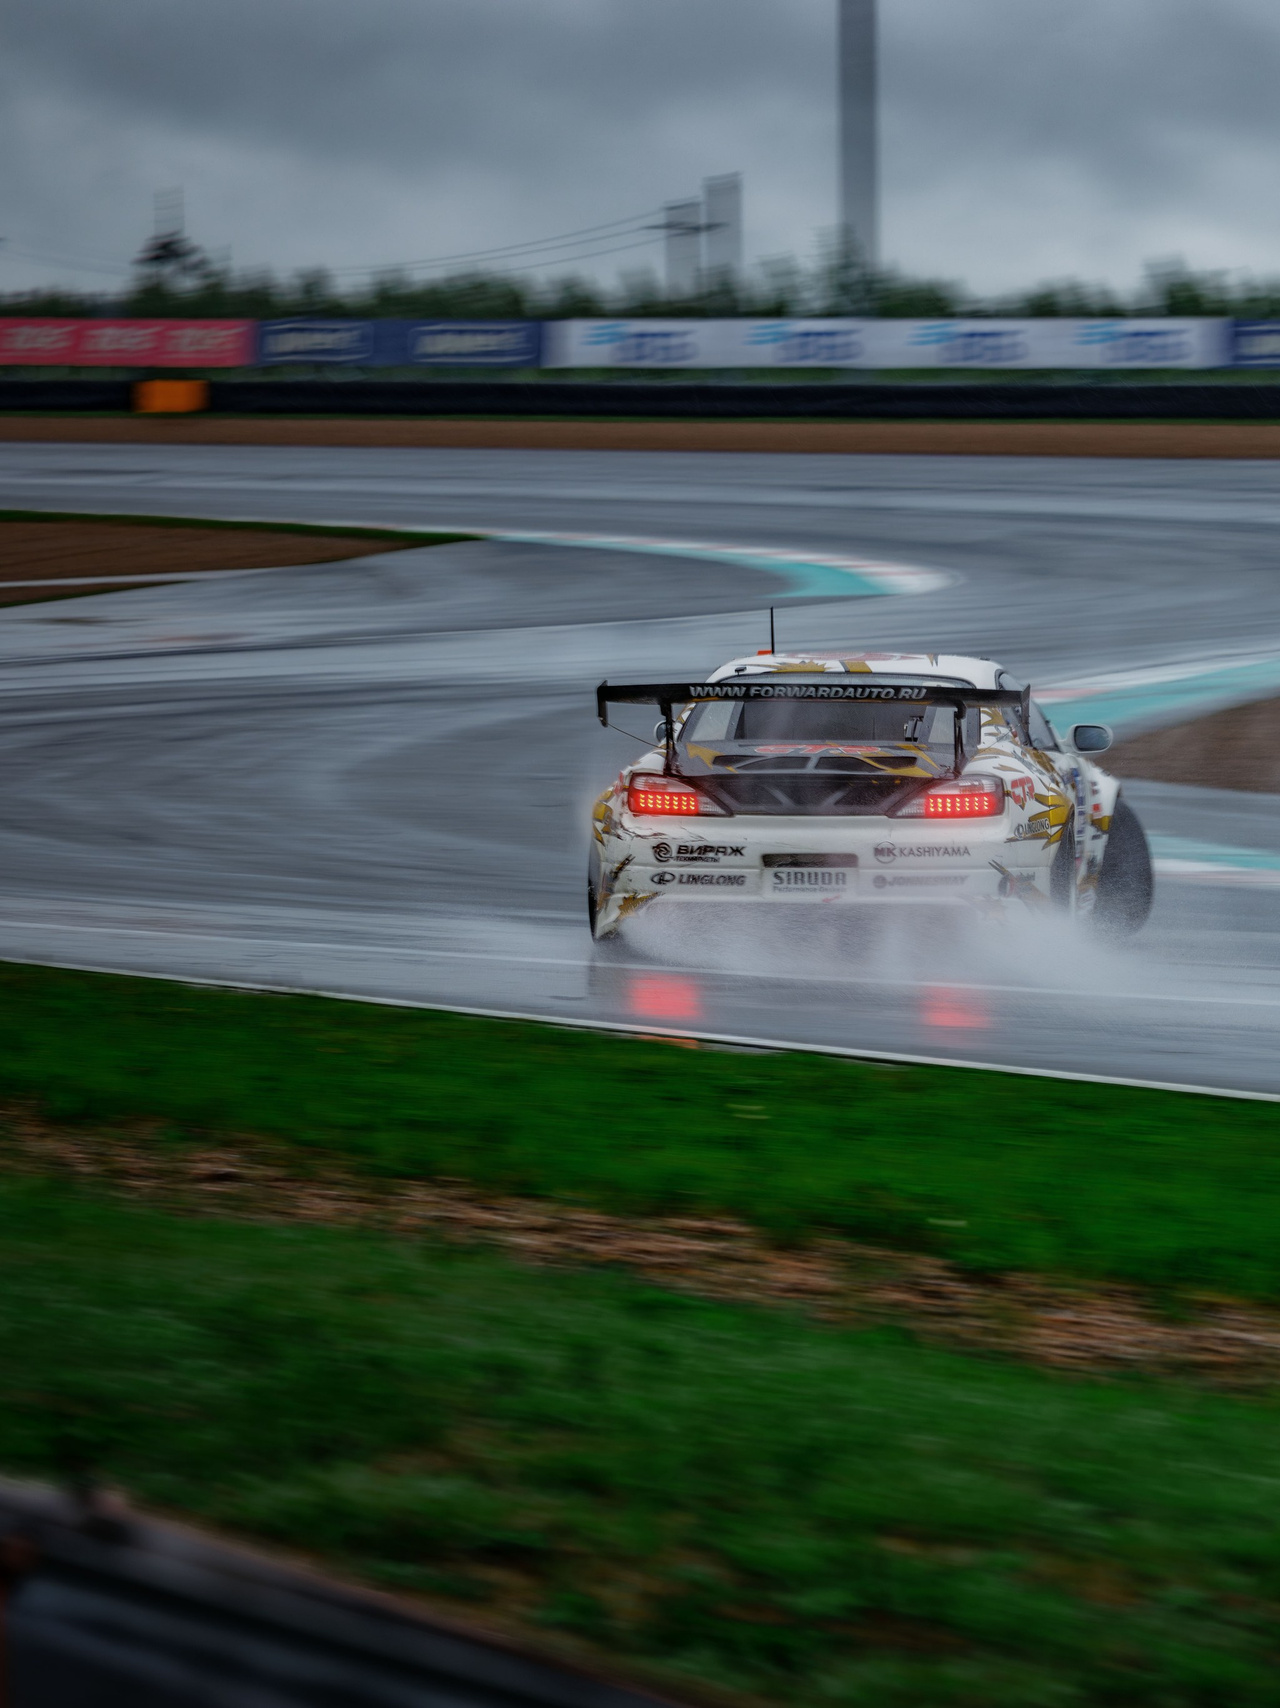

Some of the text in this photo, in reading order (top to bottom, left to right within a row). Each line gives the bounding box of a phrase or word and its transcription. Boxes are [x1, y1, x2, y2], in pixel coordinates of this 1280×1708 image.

[1024, 818, 1050, 835] LINGLONG
[677, 845, 746, 857] ВИРАЖ
[899, 846, 970, 858] KASHIYAMA
[679, 874, 747, 886] LINGLONG
[773, 871, 847, 886] SIRUDA
